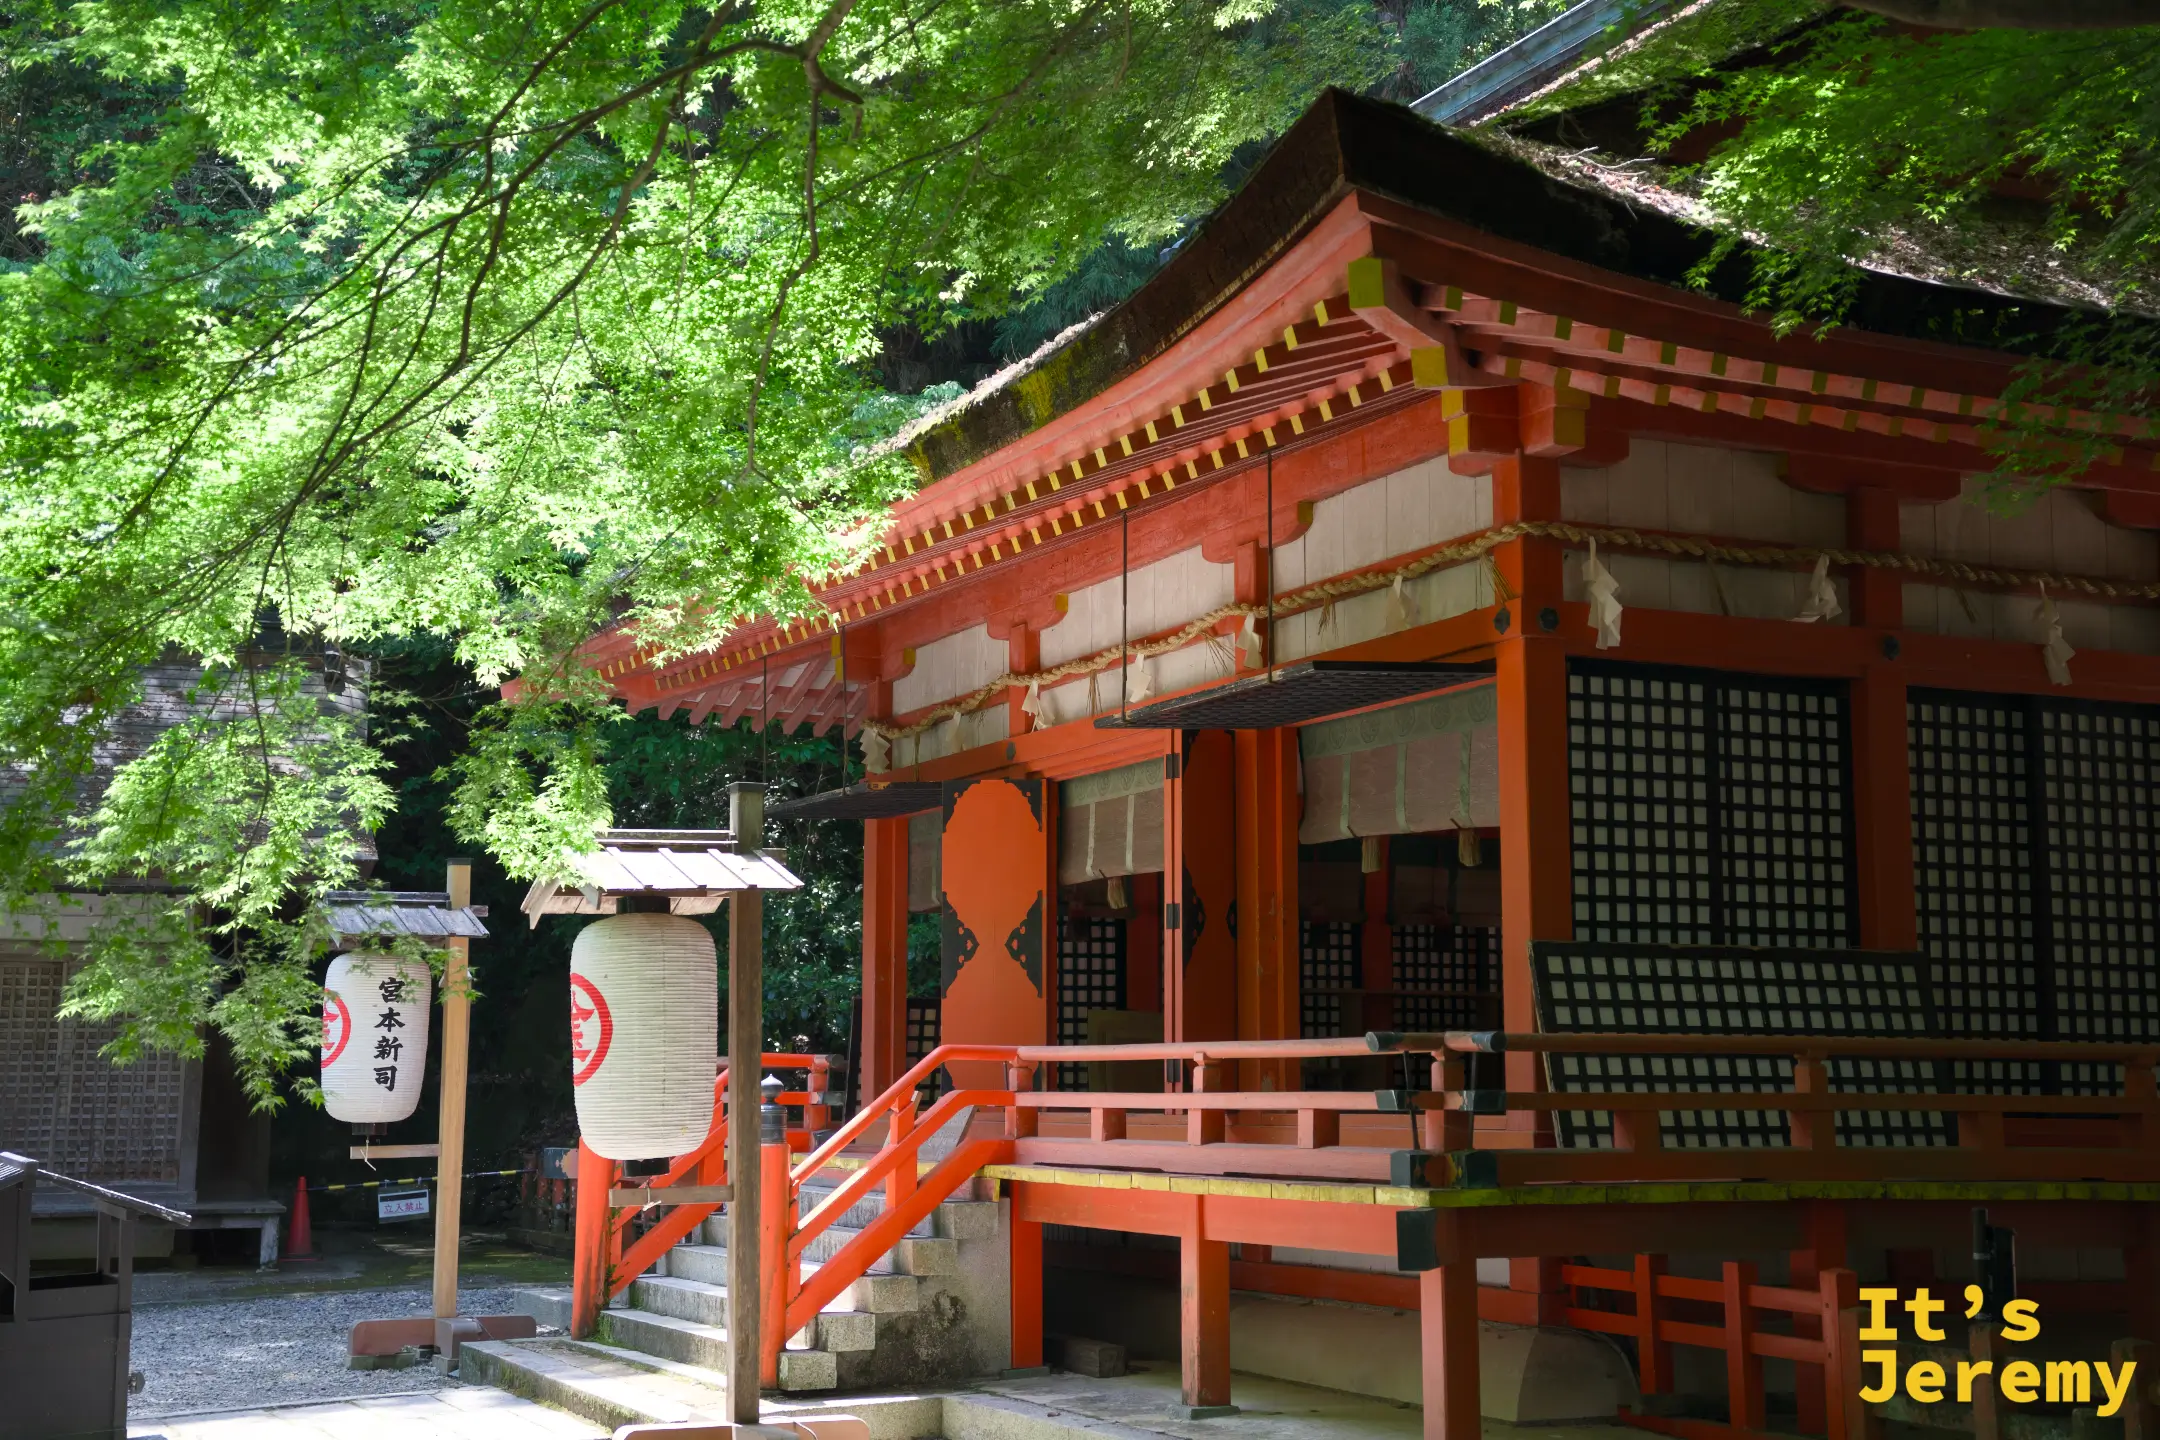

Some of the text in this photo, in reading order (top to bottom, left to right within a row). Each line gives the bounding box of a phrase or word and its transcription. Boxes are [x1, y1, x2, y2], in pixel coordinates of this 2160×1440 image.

[373, 976, 406, 1092] 宮本新司
[384, 1201, 424, 1214] 立入禁止
